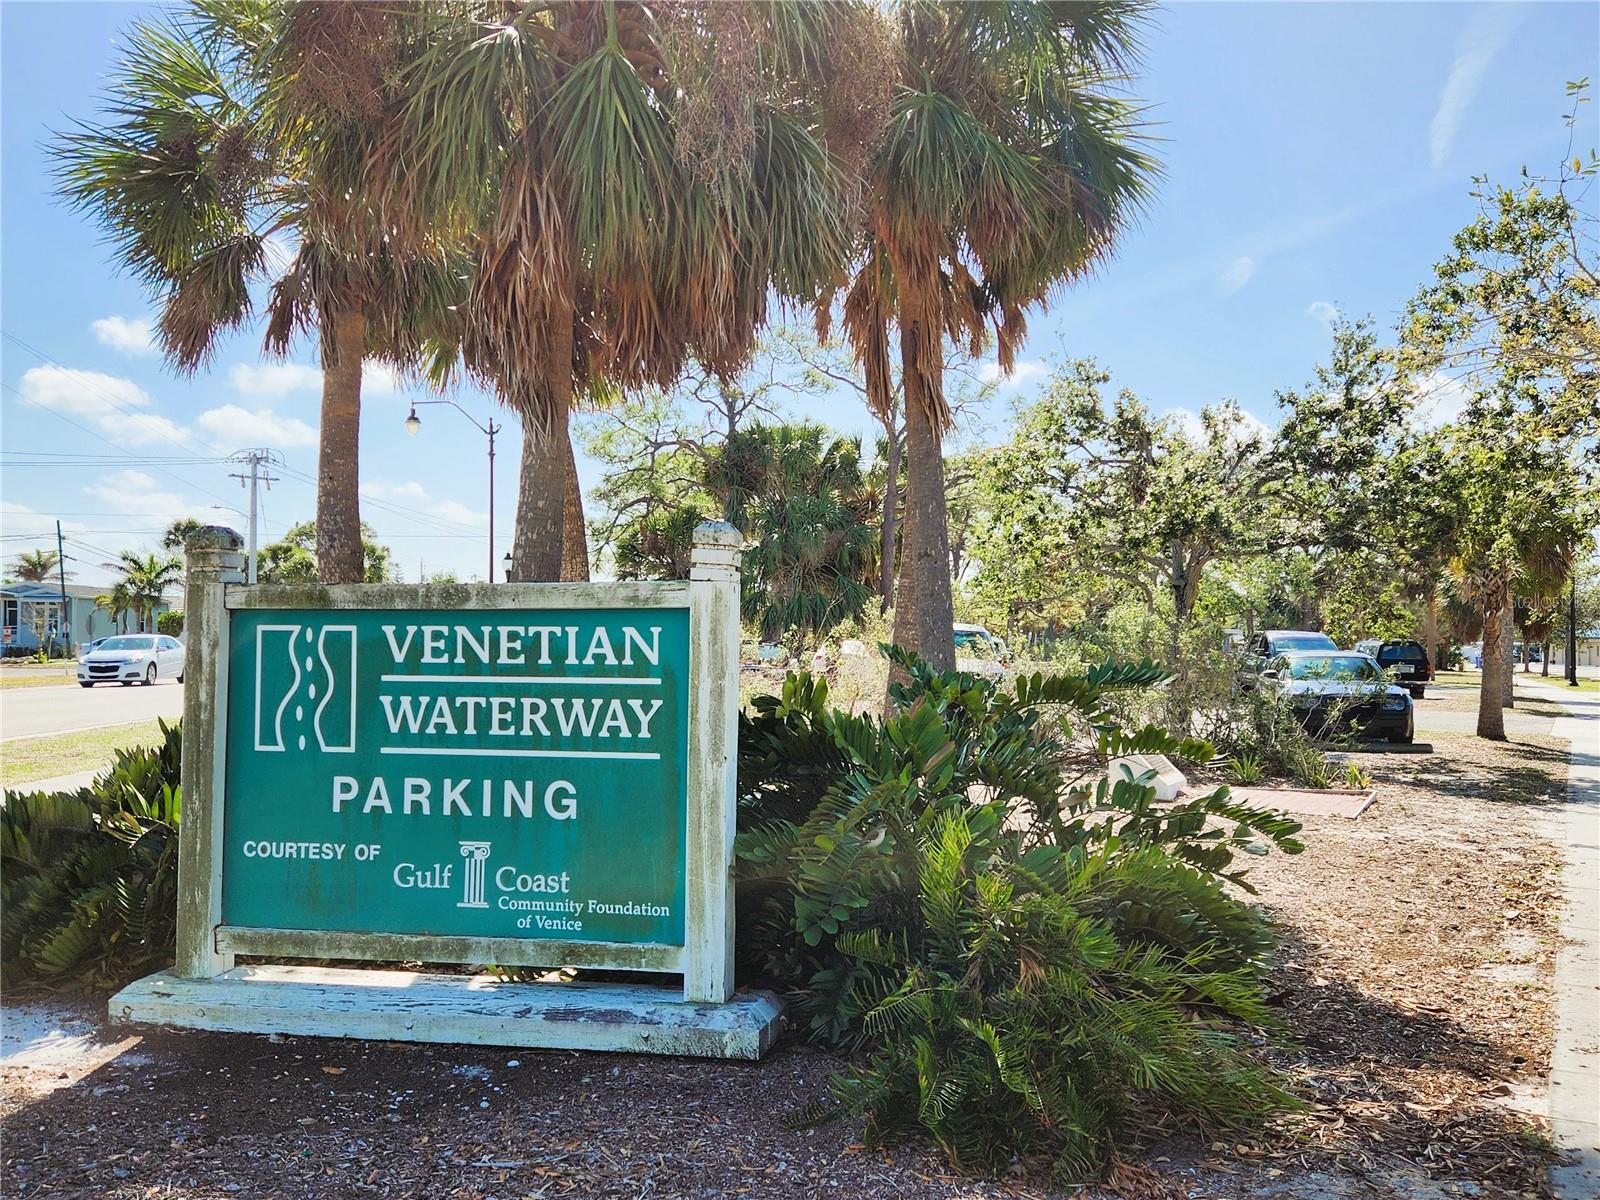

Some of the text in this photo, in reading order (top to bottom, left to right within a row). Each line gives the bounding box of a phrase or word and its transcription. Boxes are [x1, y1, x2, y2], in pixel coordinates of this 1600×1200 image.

[381, 625, 662, 666] VENETIAN
[379, 695, 664, 738] WATERWAY
[332, 775, 577, 820] PARKING
[243, 840, 381, 861] COURTESY OF
[393, 863, 570, 893] Gulf Coast
[498, 896, 670, 917] Community Foundation
[517, 914, 582, 931] of Venice
